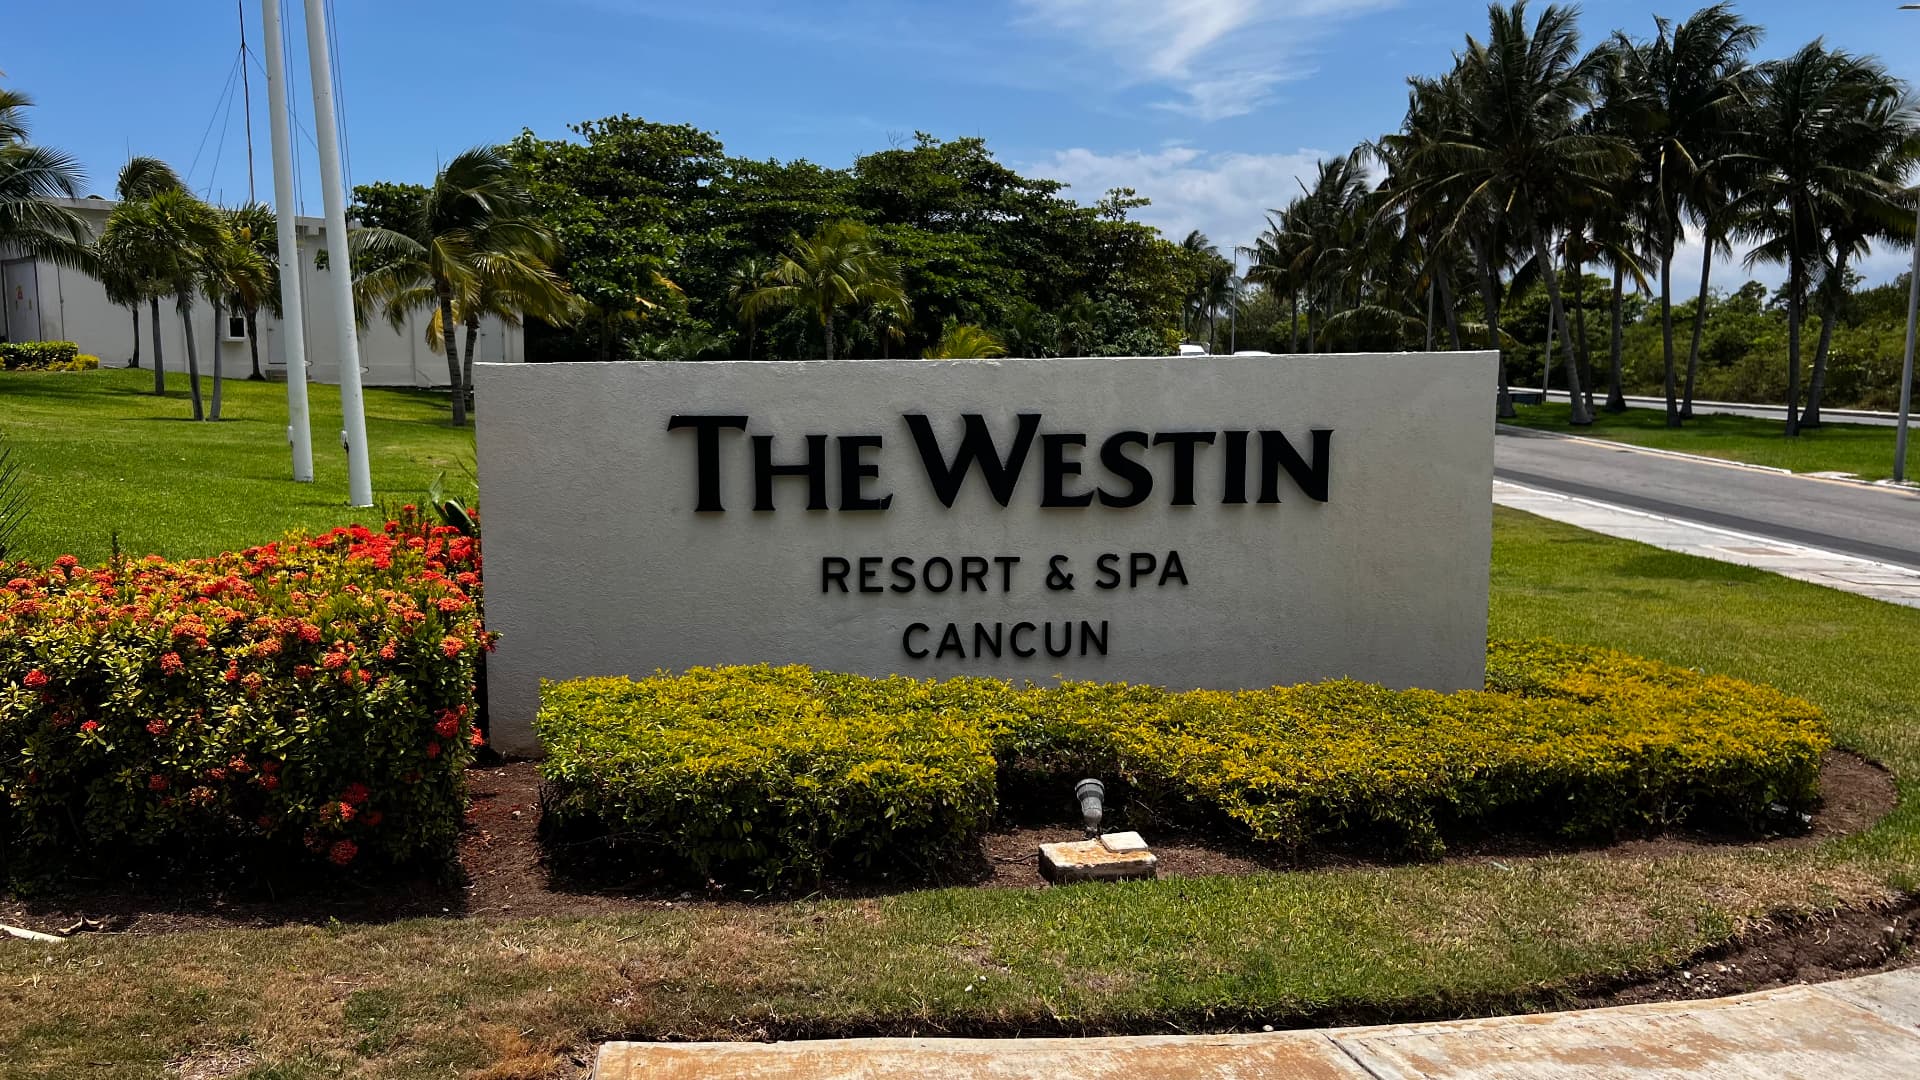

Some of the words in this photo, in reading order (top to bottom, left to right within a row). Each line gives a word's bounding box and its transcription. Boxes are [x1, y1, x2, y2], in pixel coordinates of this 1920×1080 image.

[667, 414, 893, 512] THE
[902, 413, 1334, 509] WESTIN
[822, 556, 1020, 594] RESORT
[1045, 555, 1076, 591] &
[1094, 551, 1189, 590] SPA
[901, 620, 1109, 660] CANCUN
